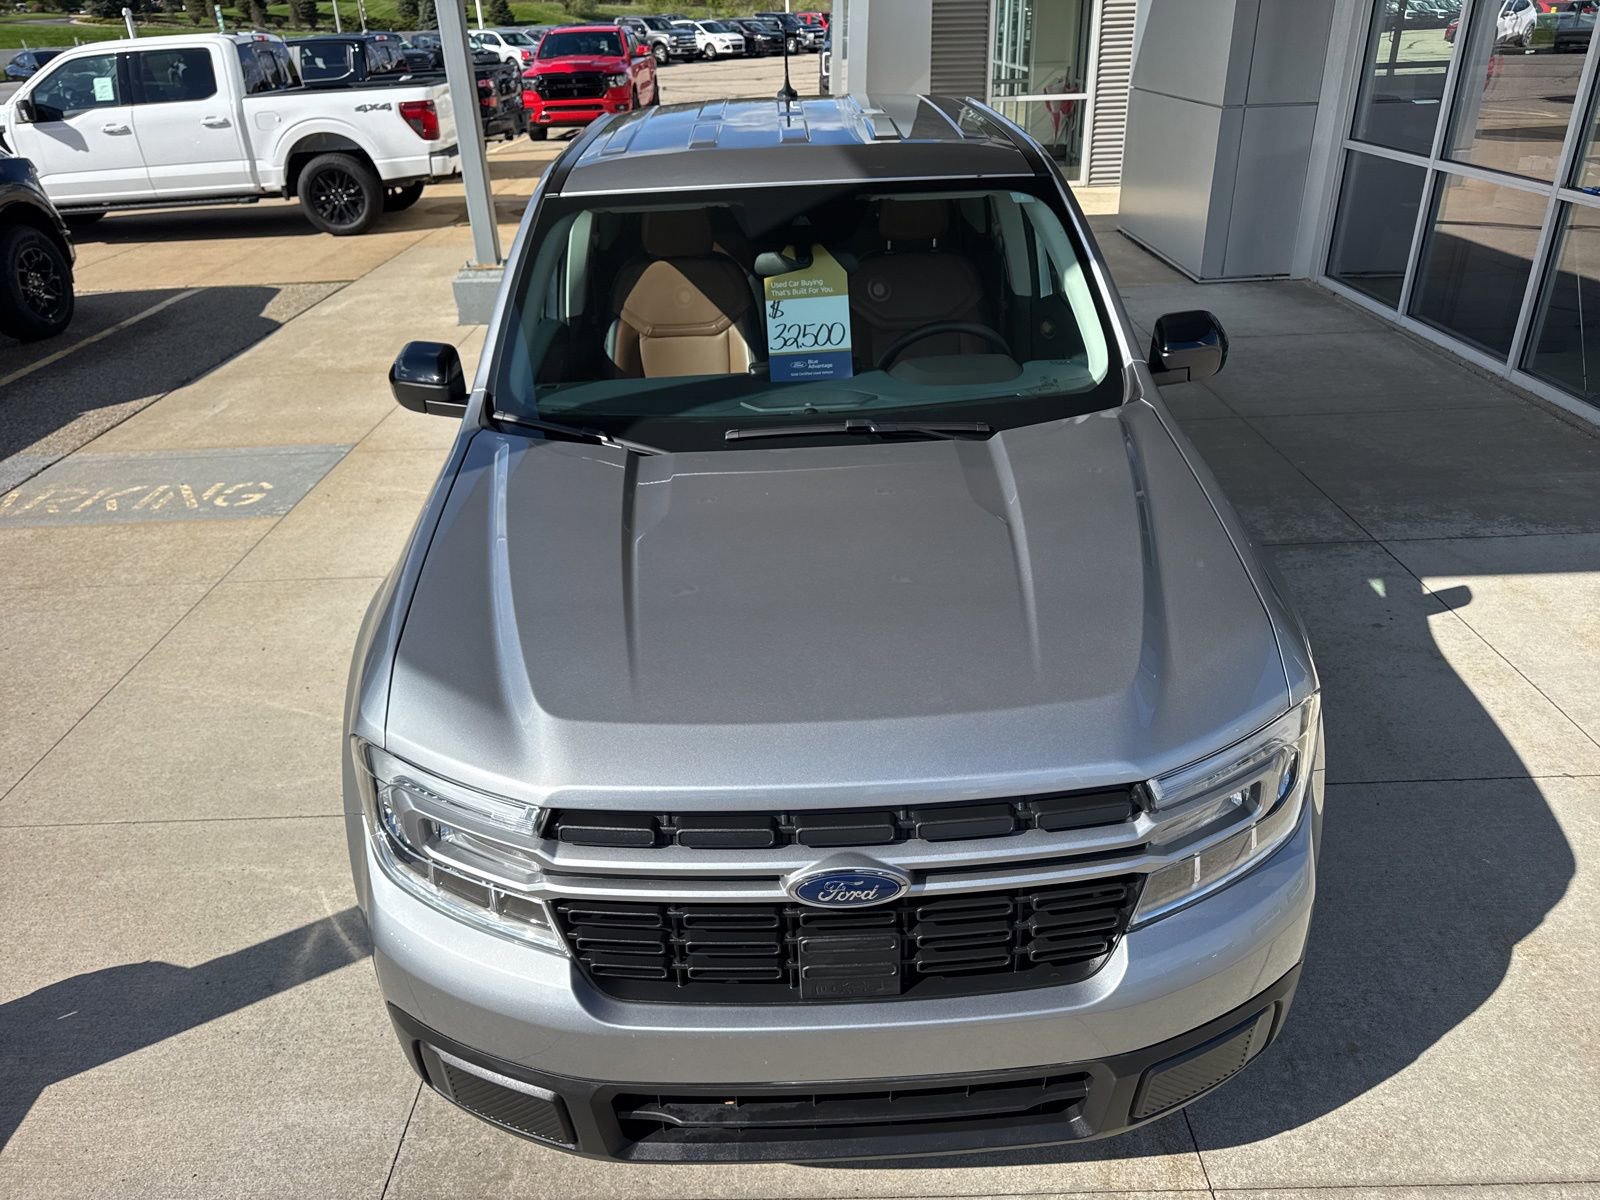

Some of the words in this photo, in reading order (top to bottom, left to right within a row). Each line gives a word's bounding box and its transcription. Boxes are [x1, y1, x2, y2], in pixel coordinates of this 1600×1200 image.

[770, 281, 787, 289] Used
[788, 280, 799, 288] Car
[800, 279, 824, 287] Buying
[791, 288, 807, 296] Built
[808, 287, 819, 295] For
[818, 881, 880, 901] Ford
